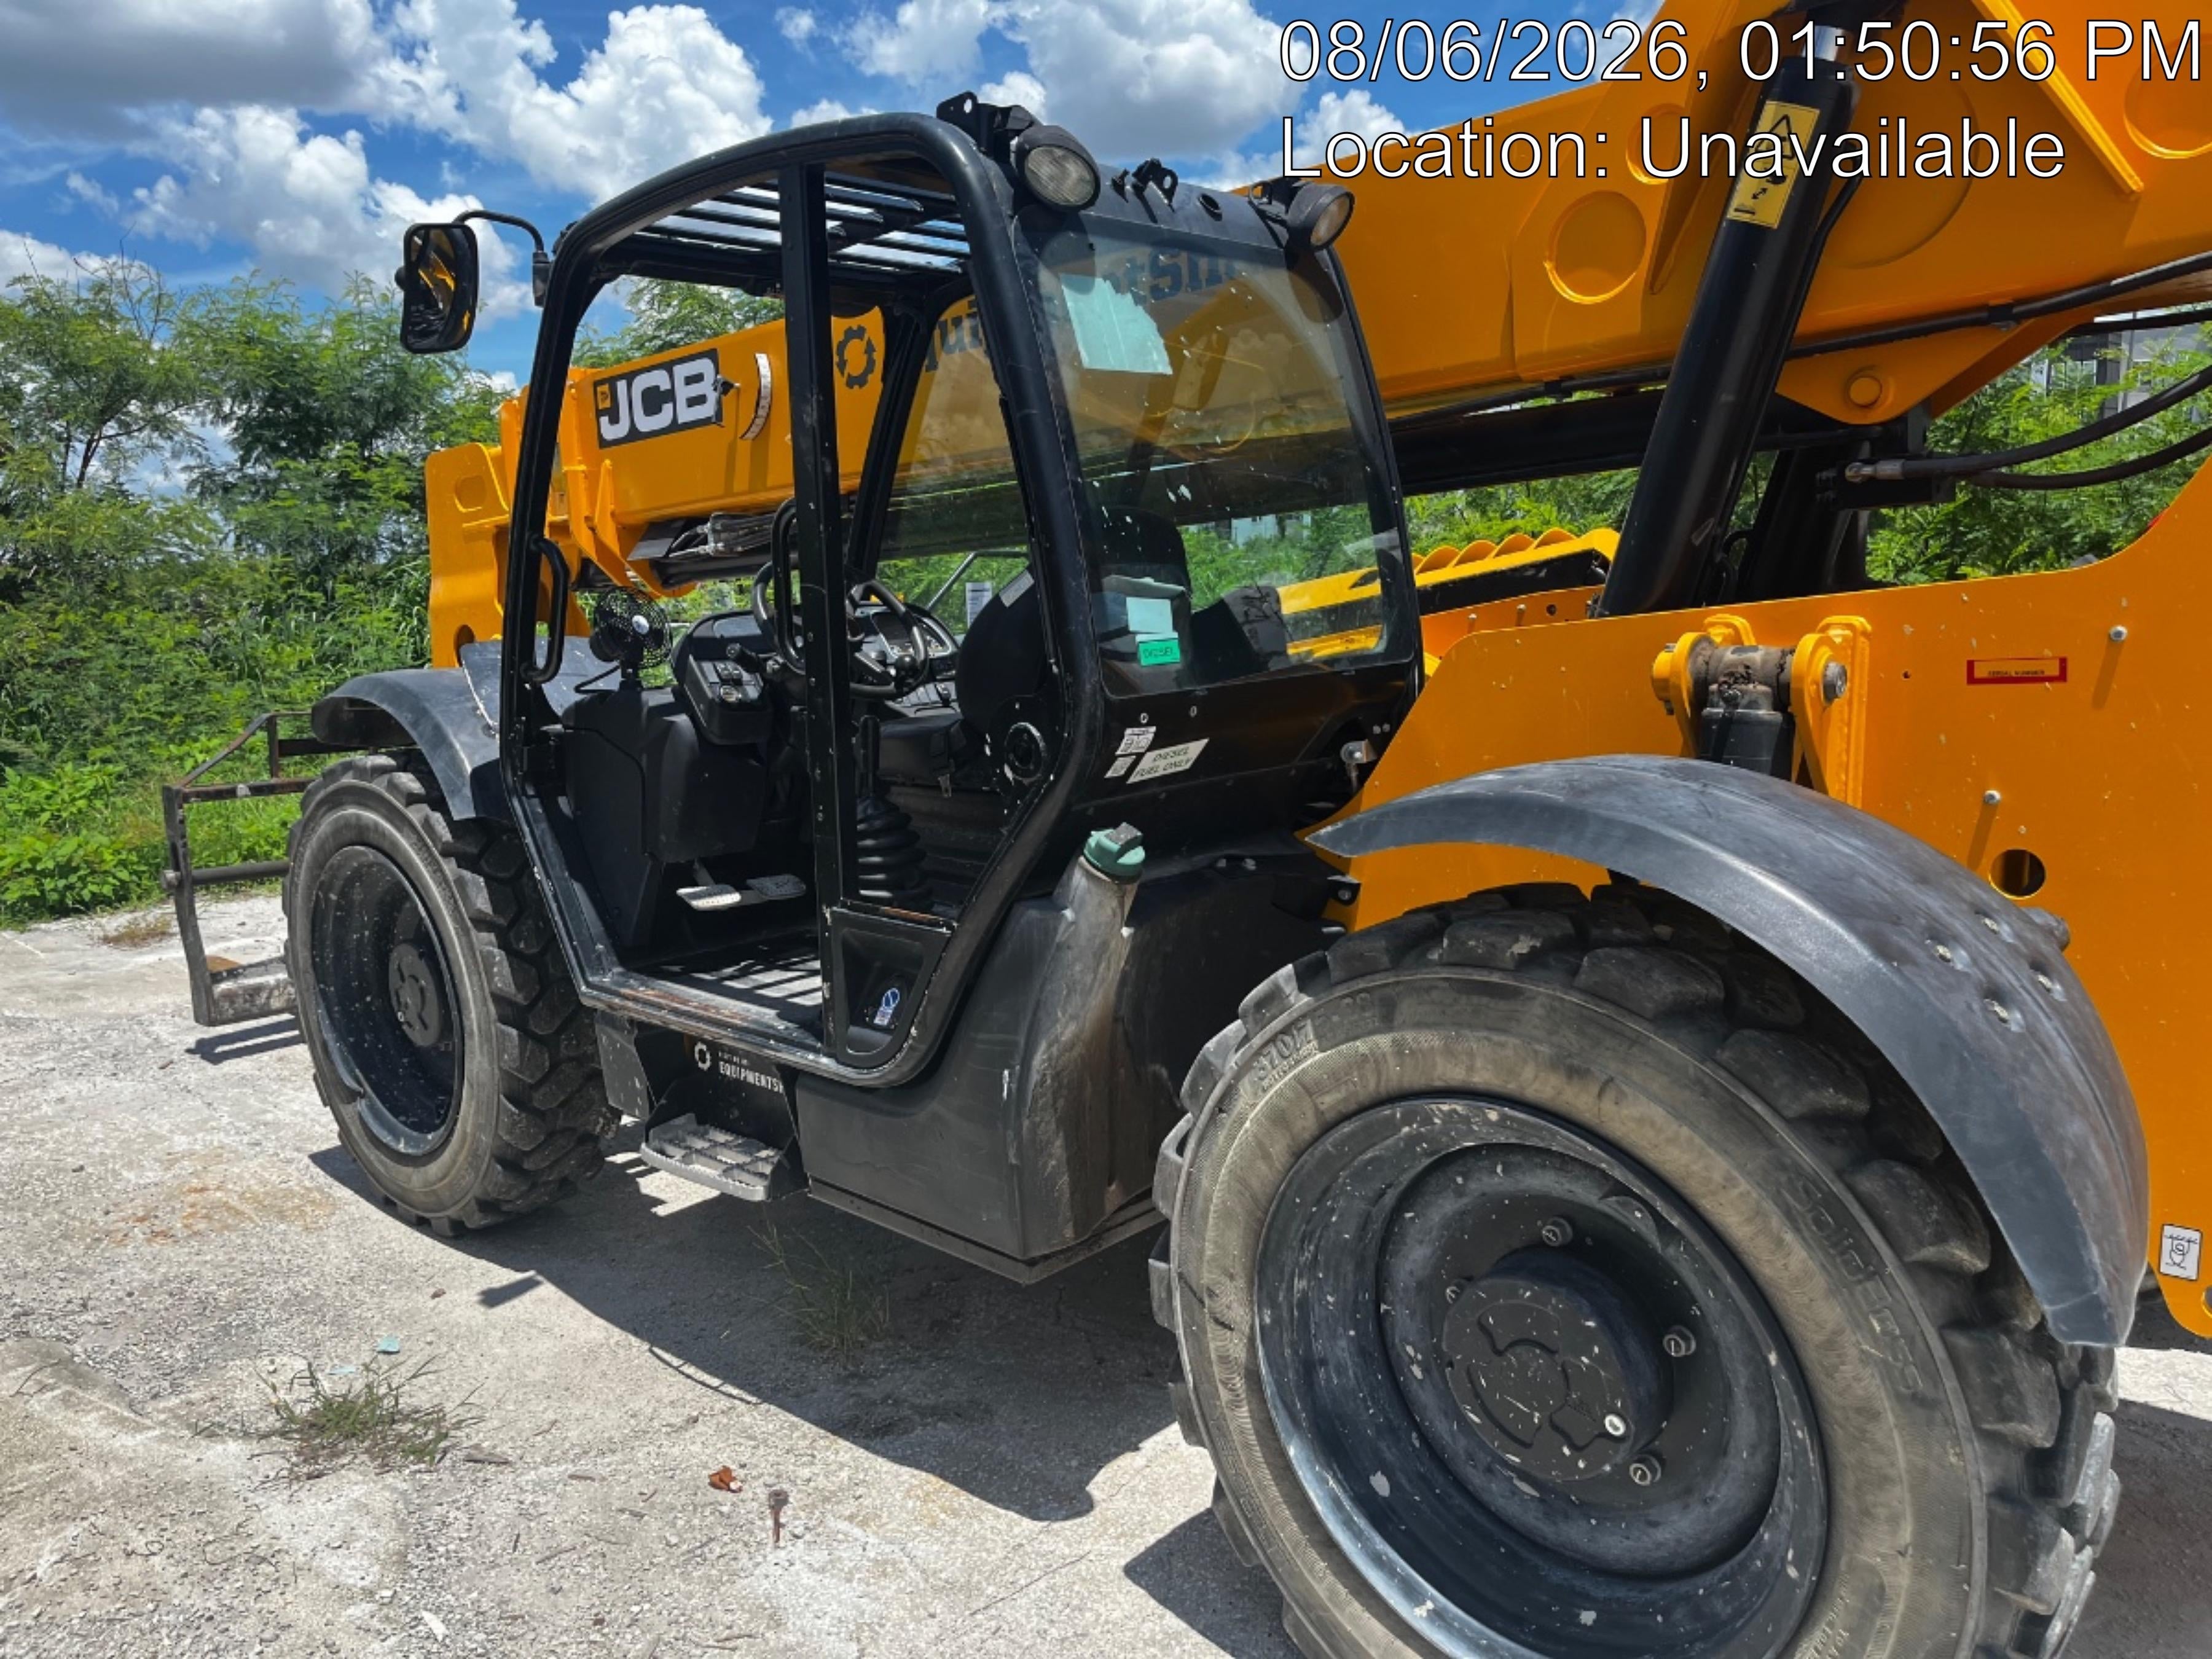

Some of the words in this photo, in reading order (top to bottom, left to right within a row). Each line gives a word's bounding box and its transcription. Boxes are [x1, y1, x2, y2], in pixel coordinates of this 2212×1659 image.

[599, 357, 716, 441] JCB
[1153, 746, 1190, 763] DIESEL
[1134, 764, 1161, 779] FUEL
[1163, 756, 1193, 771] ONLY
